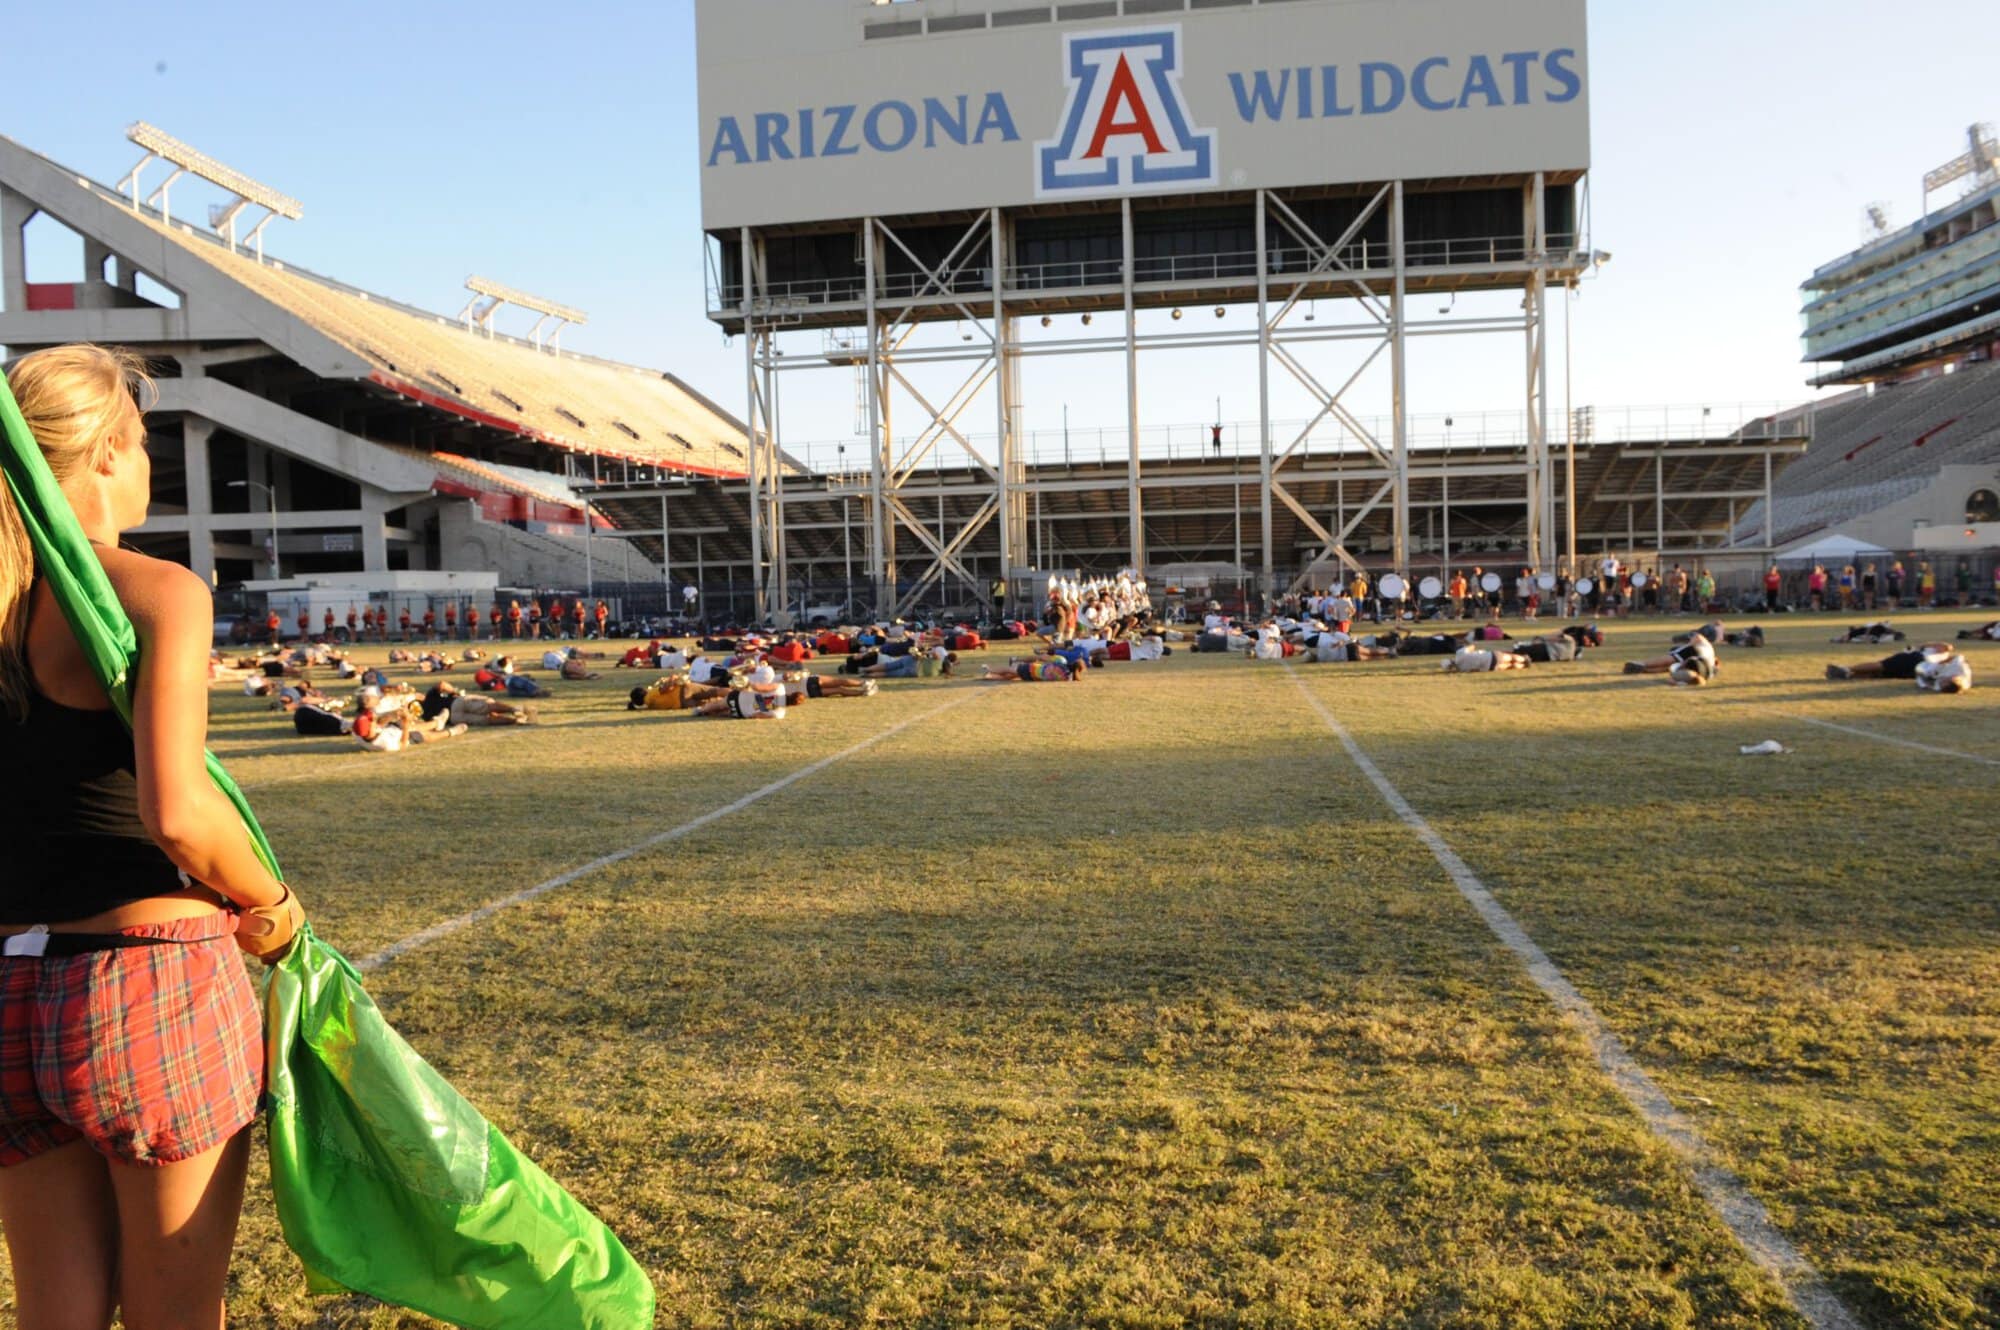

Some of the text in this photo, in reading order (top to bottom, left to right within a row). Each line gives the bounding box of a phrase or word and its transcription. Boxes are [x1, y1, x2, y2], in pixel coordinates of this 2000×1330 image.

[706, 25, 1581, 196] ARIZONA A WILDCATS
